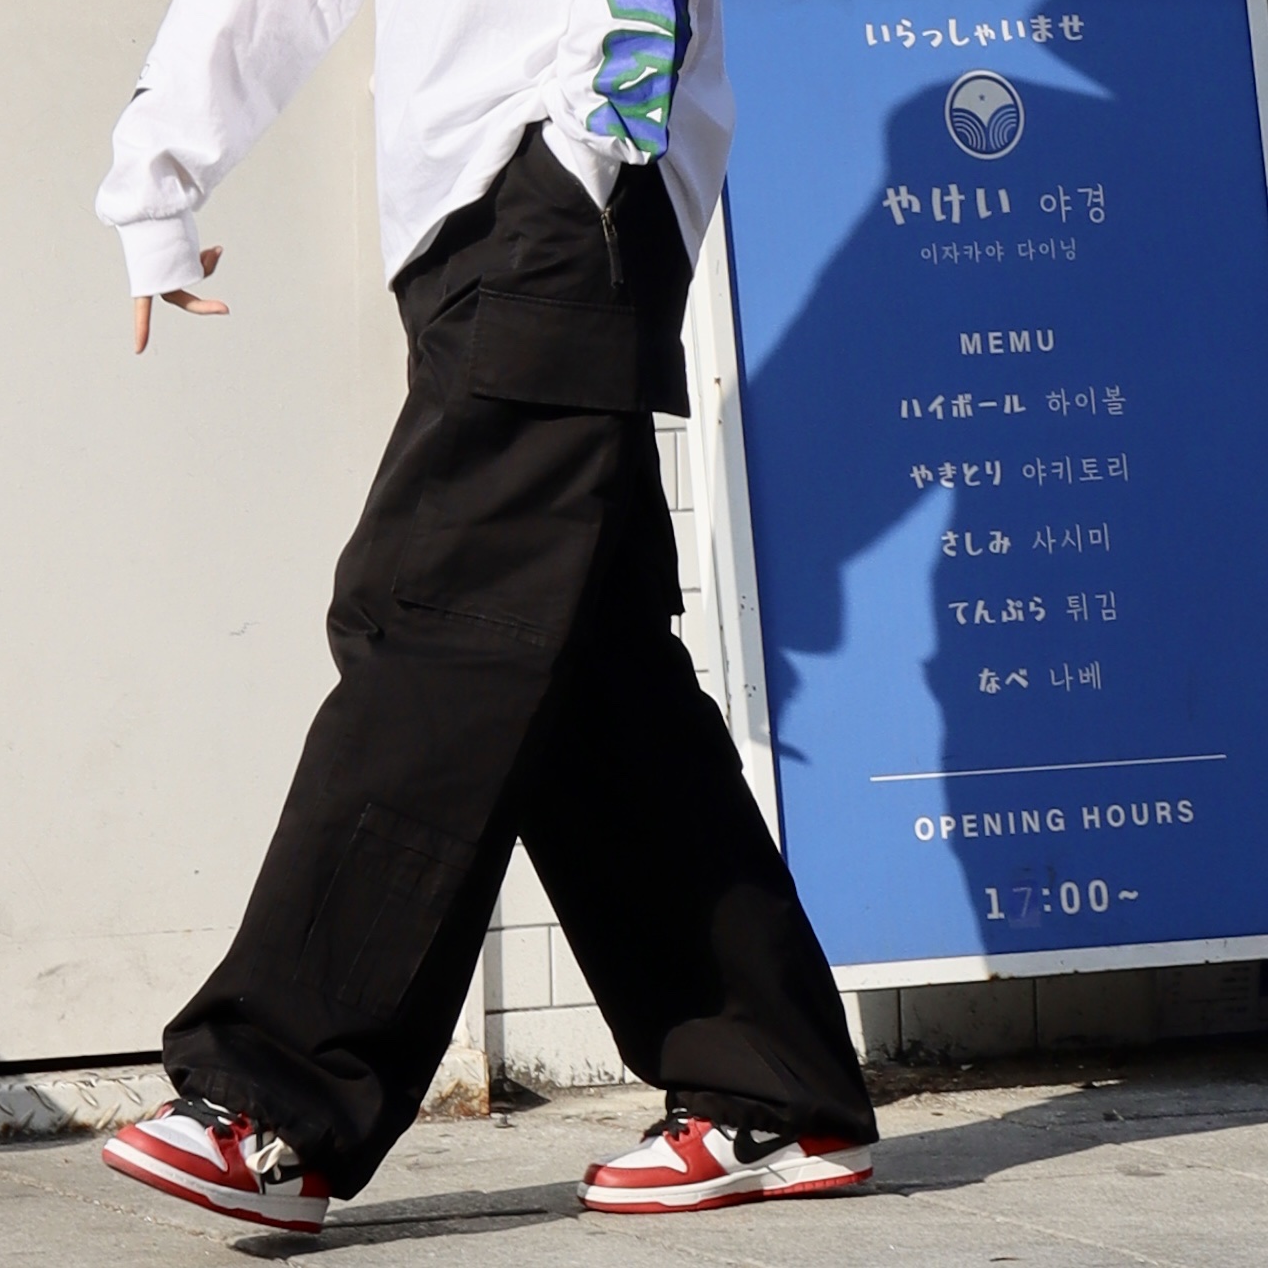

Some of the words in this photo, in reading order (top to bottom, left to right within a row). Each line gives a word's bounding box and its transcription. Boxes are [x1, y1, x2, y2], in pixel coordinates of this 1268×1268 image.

[865, 14, 1085, 48] いらっしゃいませ
[882, 184, 1011, 225] やけい
[1039, 184, 1106, 225] 야경
[920, 241, 1004, 265] 이자카야
[1017, 238, 1077, 262] 다이닝
[960, 329, 1055, 355] MEMU
[900, 392, 1027, 420] ハイボール
[1045, 384, 1126, 416] 하이볼
[909, 460, 1001, 489] やきとり
[1022, 453, 1130, 486] 야키토리
[940, 530, 1012, 557] さしみ
[1032, 522, 1111, 555] 사시미
[948, 596, 1046, 625] てんぷら
[1066, 591, 1118, 621] 튀김
[978, 667, 1029, 694] なべ
[1049, 661, 1102, 692] 나베
[914, 808, 1067, 841] OPENING
[1082, 800, 1195, 830] HOURS
